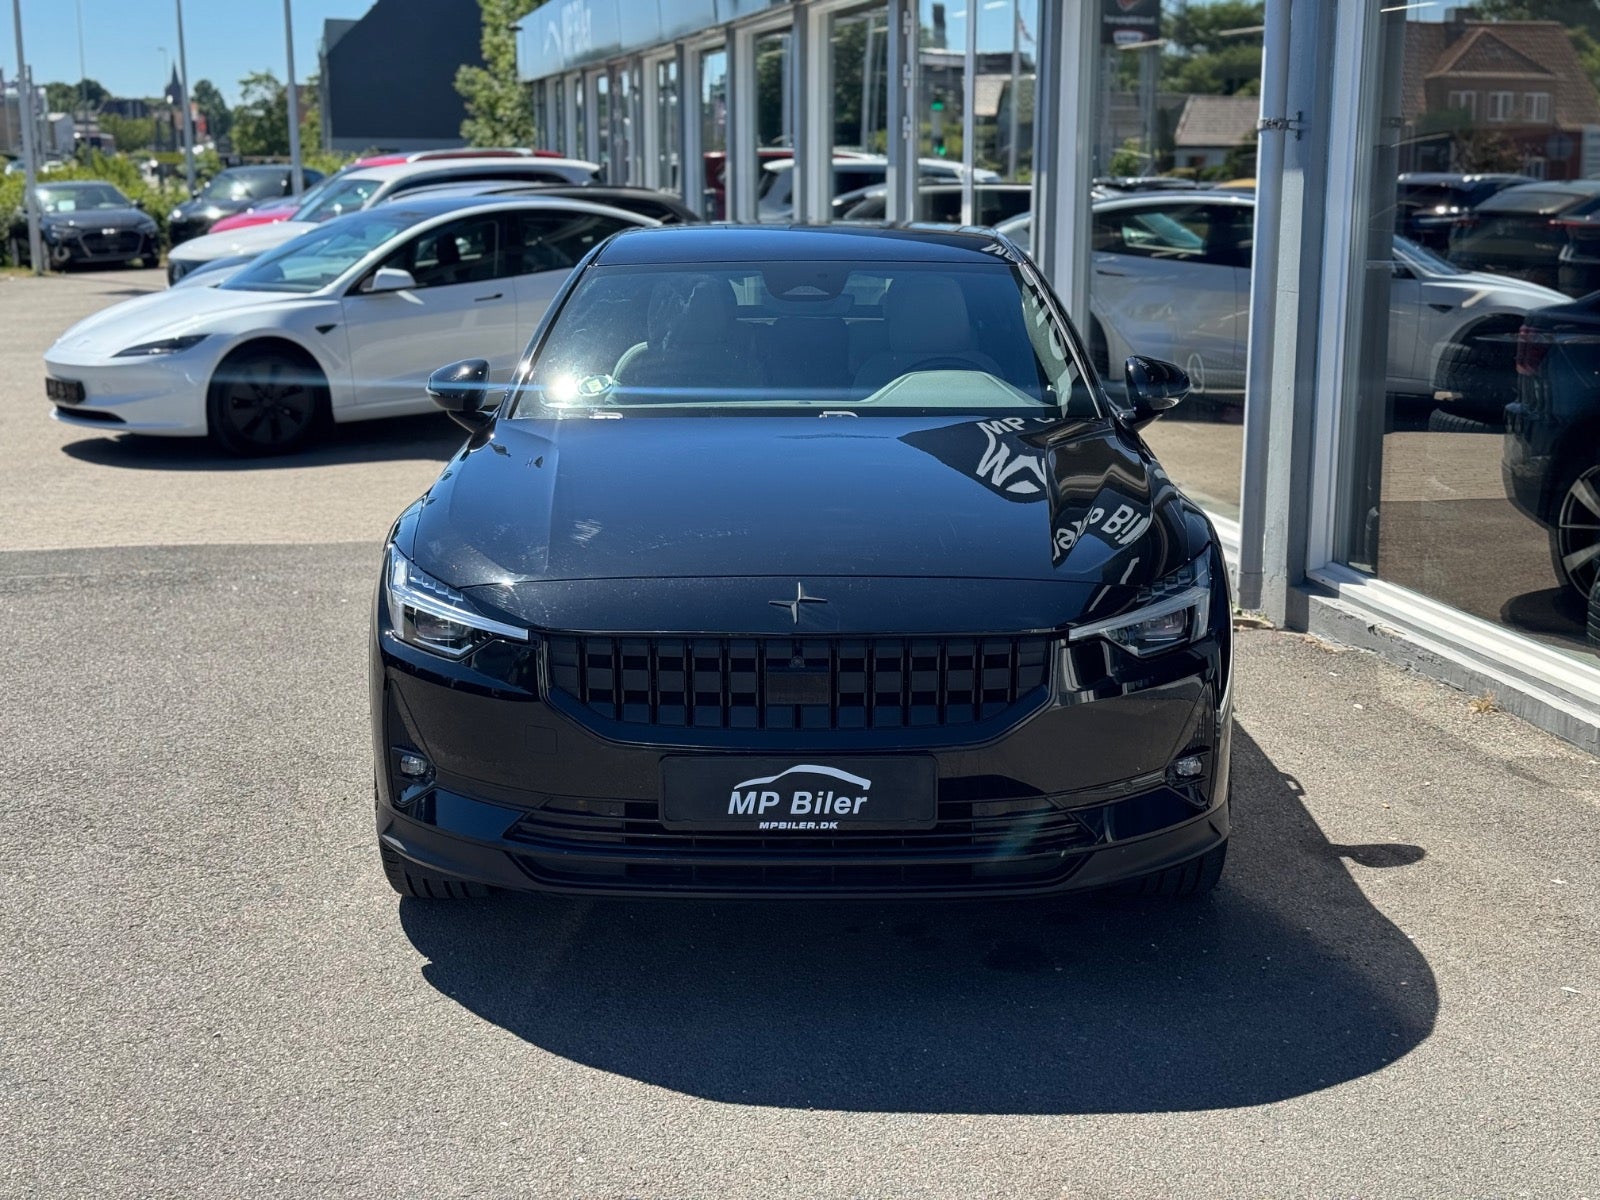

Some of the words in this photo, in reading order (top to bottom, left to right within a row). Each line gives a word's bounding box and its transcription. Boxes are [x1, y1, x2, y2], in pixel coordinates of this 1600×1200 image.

[727, 791, 779, 815] MP
[790, 791, 867, 815] Biler
[759, 821, 839, 830] MPBILER.DK
